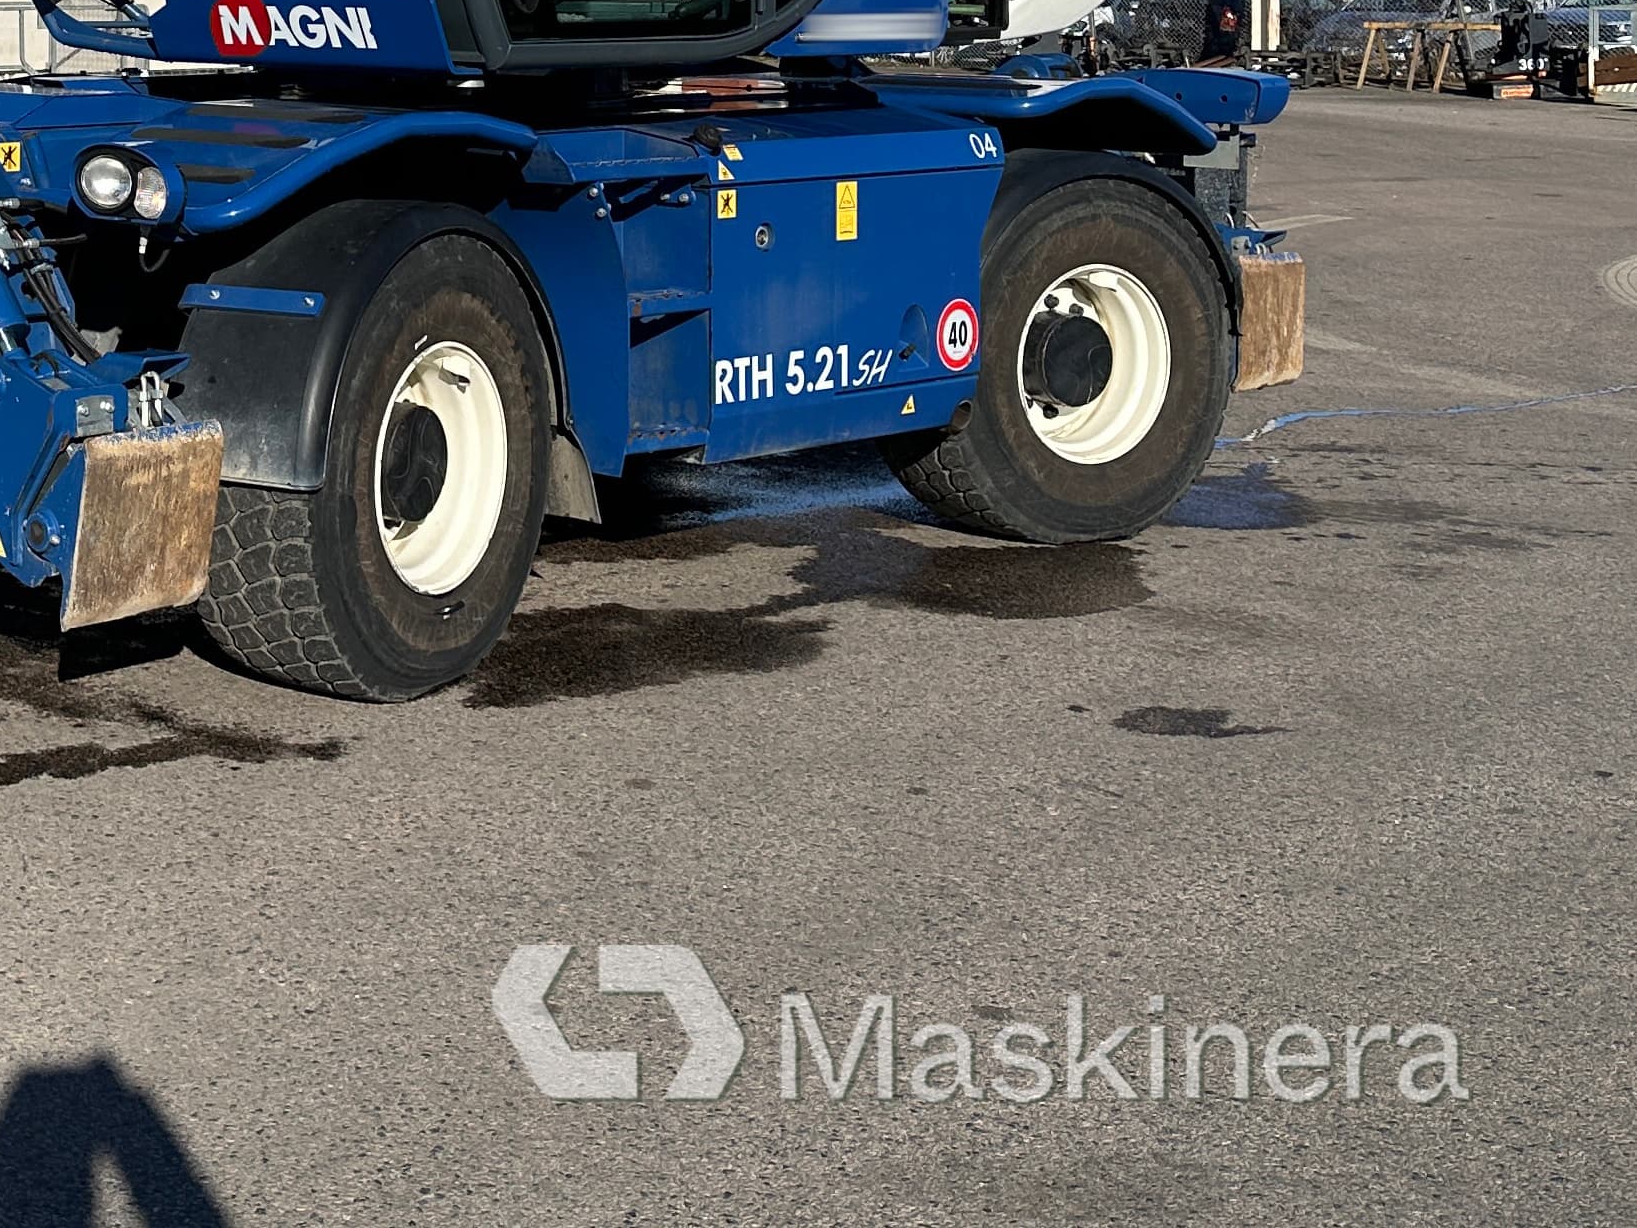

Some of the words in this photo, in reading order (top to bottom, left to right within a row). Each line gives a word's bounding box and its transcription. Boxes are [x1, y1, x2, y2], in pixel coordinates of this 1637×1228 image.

[217, 4, 378, 50] MAGNI
[969, 132, 998, 159] 04
[948, 320, 968, 348] 40
[715, 353, 774, 405] RTH
